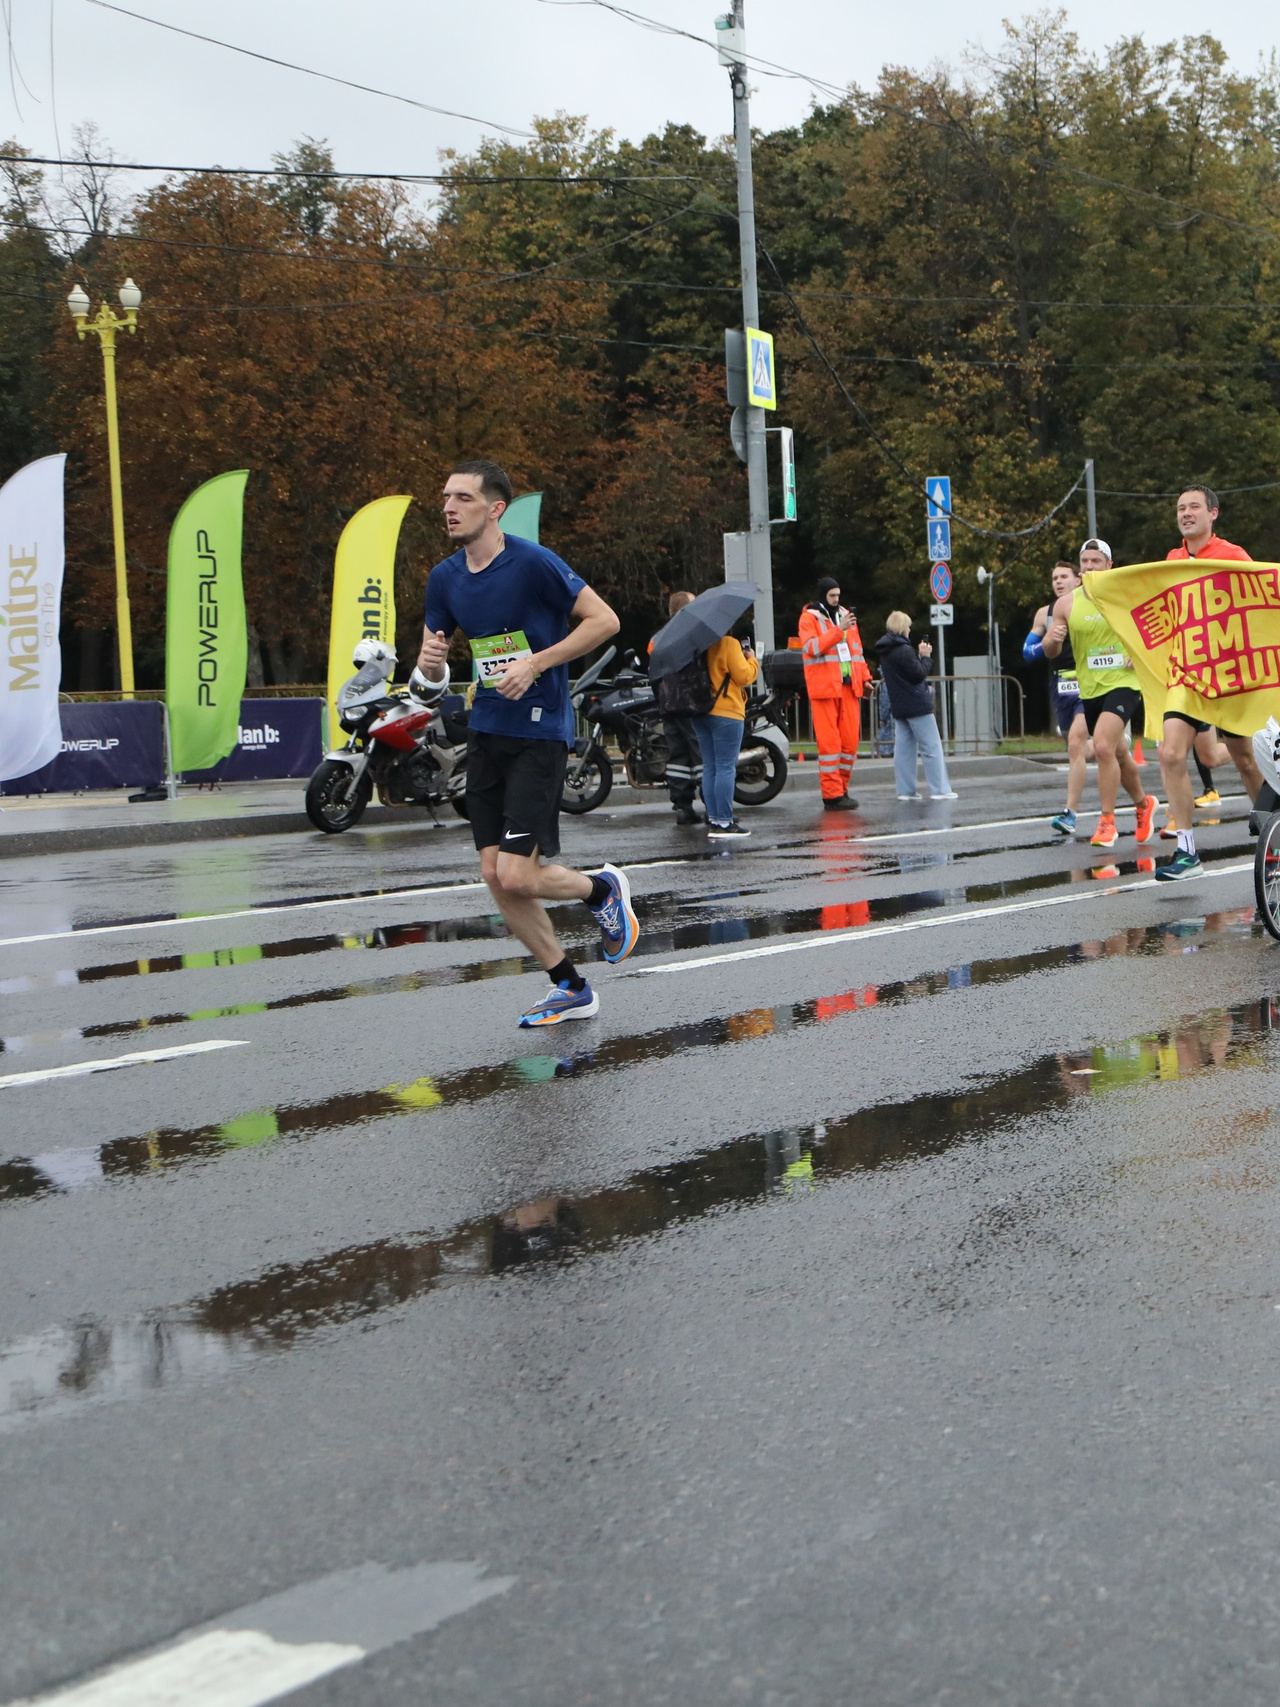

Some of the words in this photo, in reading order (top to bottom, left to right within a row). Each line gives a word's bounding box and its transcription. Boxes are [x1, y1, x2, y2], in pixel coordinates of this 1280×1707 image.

[196, 529, 218, 707] POWERUP
[1092, 656, 1115, 667] 4119
[1060, 681, 1080, 692] 663
[237, 725, 263, 744] lan
[59, 738, 120, 753] OWERUP
